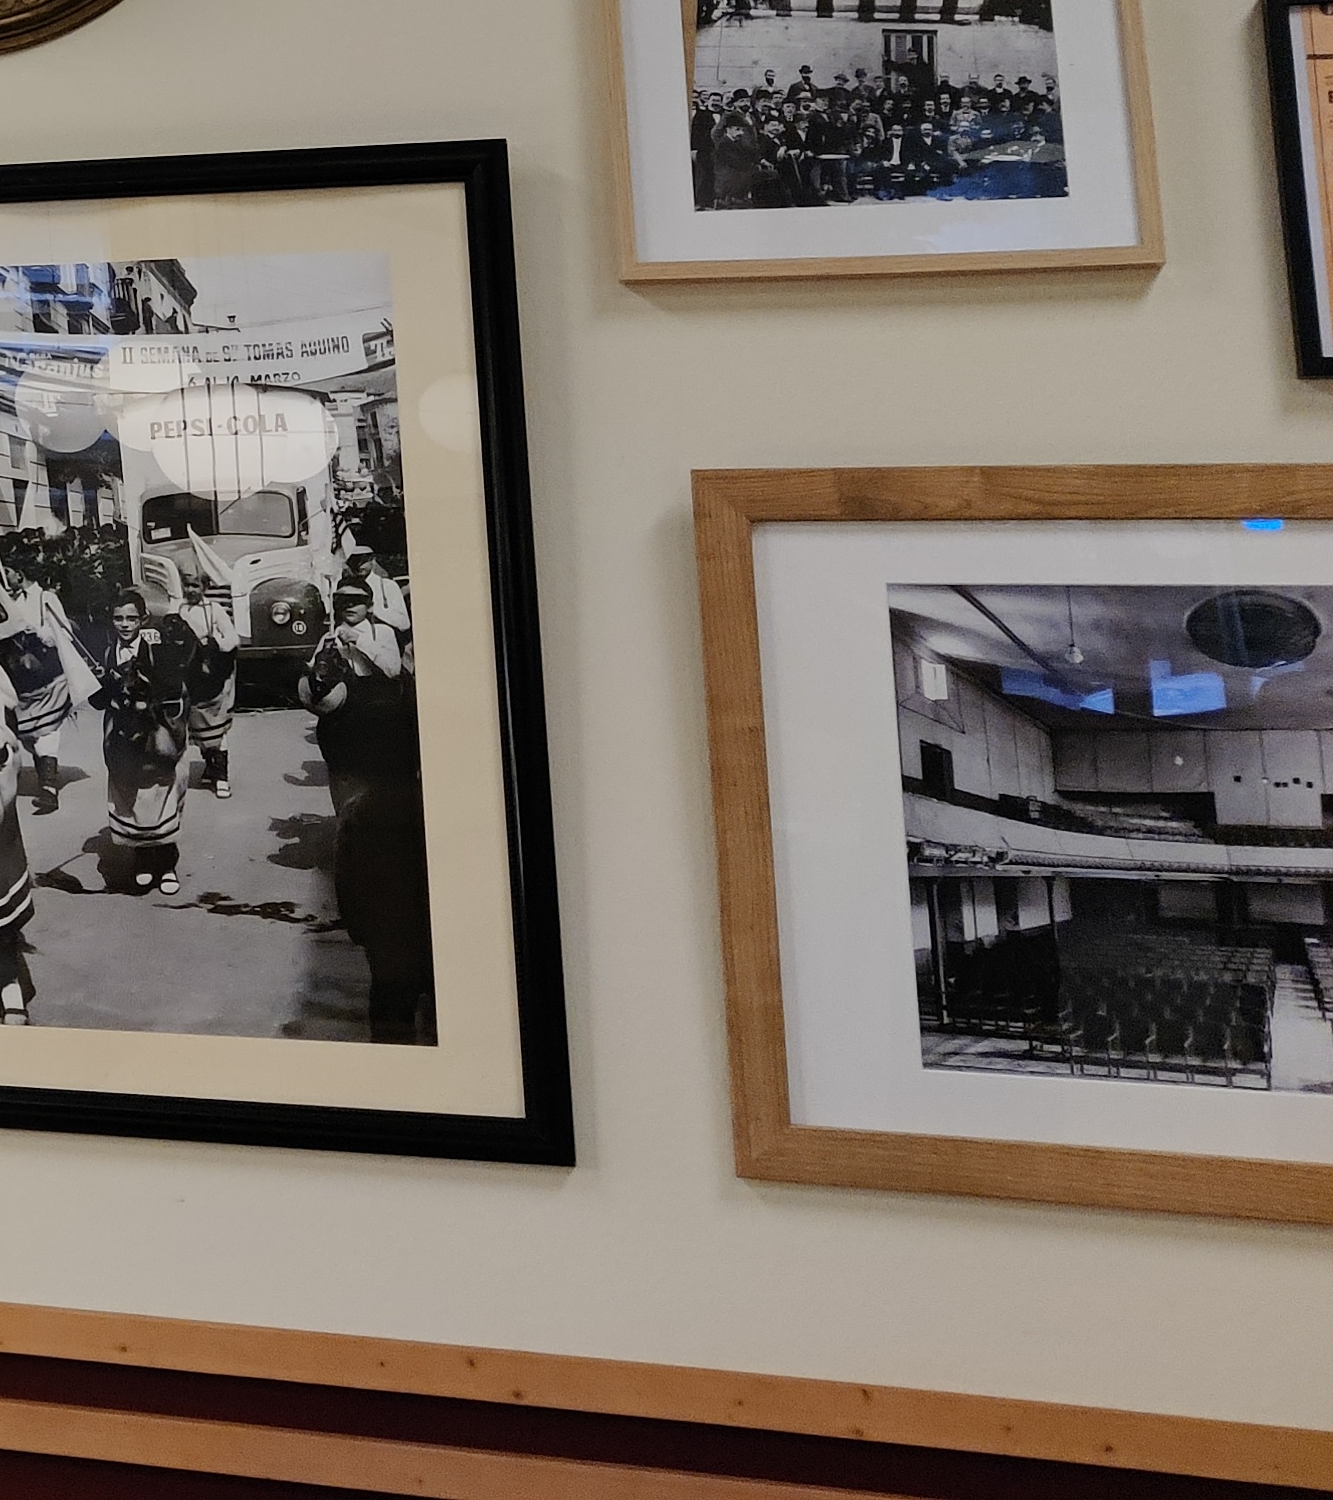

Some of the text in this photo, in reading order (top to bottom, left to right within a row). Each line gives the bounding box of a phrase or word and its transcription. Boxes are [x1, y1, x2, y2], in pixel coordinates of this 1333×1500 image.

[122, 347, 133, 364] II
[244, 342, 293, 362] TOMAS
[250, 372, 301, 384] MARZO
[150, 413, 288, 440] PEPSI-COLA
